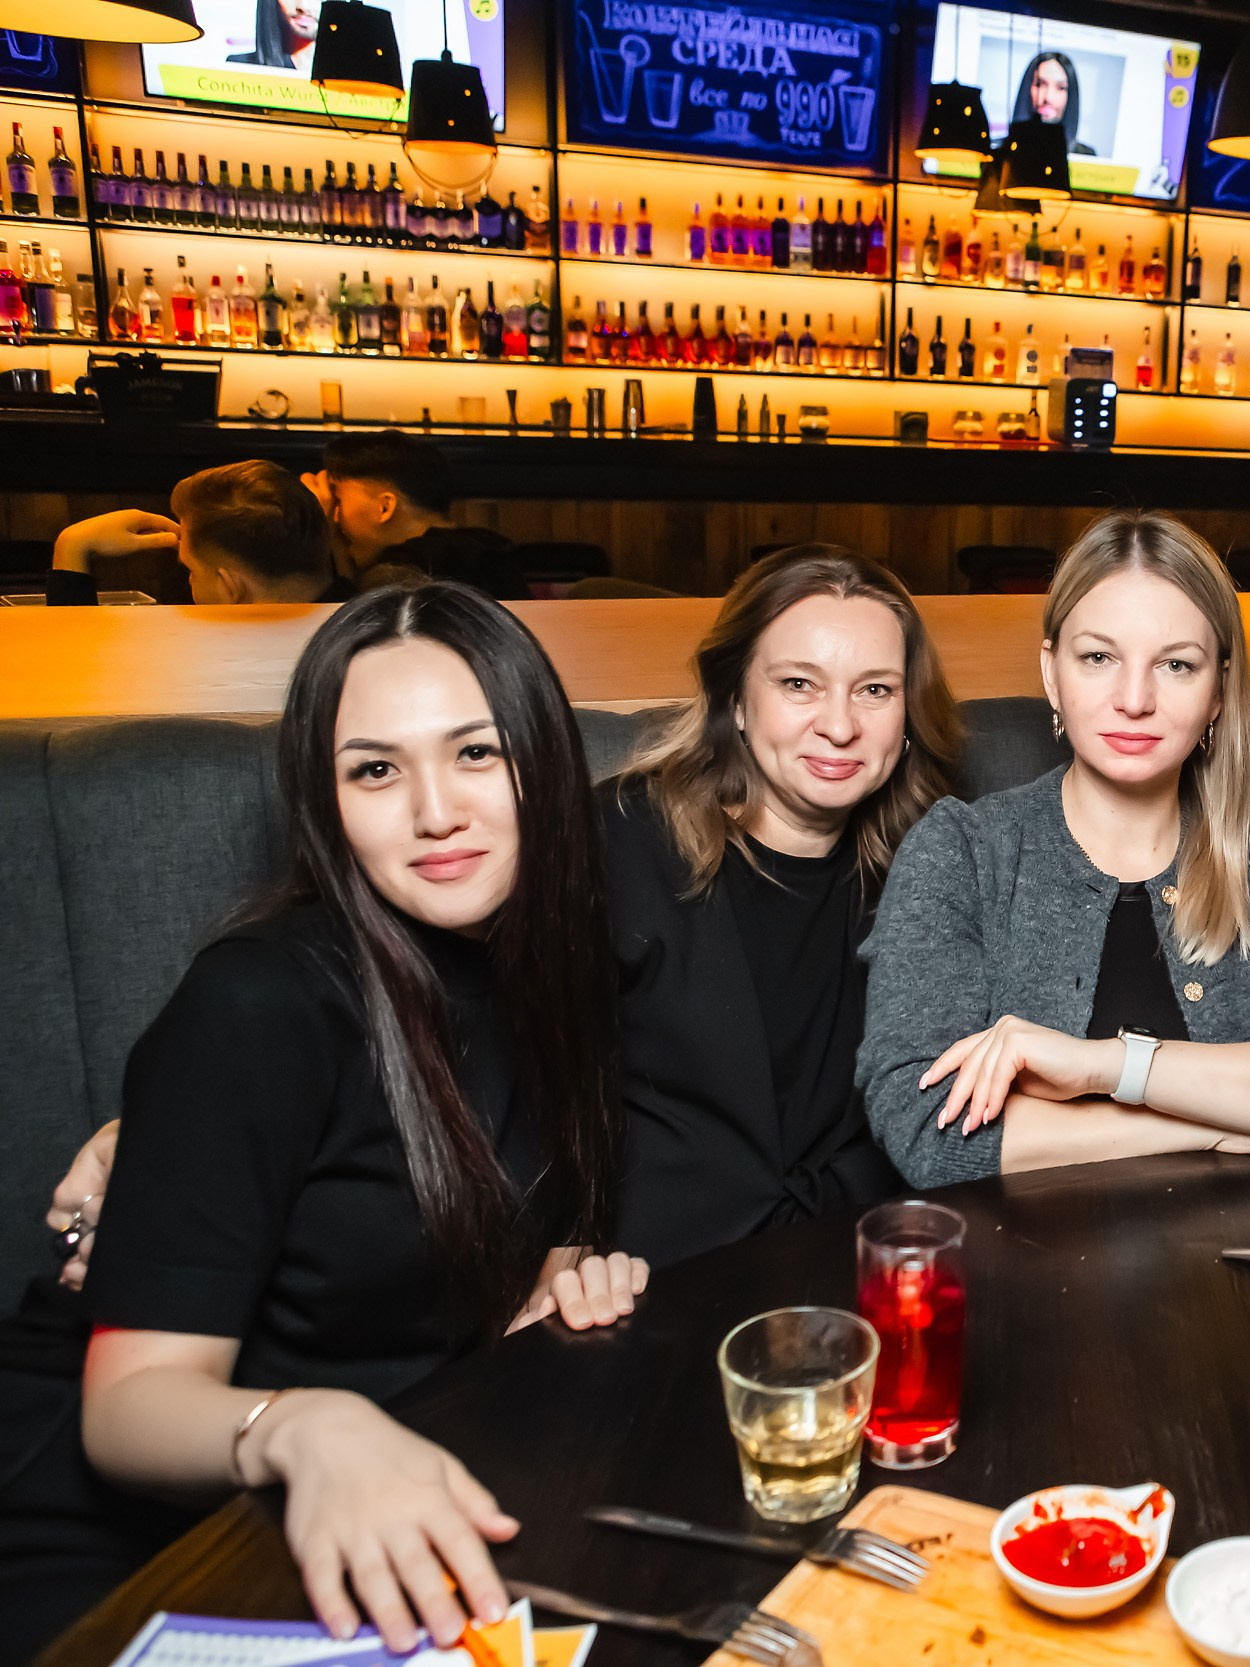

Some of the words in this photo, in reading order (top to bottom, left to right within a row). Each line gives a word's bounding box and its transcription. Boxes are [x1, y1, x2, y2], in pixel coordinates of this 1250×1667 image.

[671, 37, 797, 78] СРЕДА
[197, 76, 273, 98] Conchita
[775, 79, 835, 133] 990
